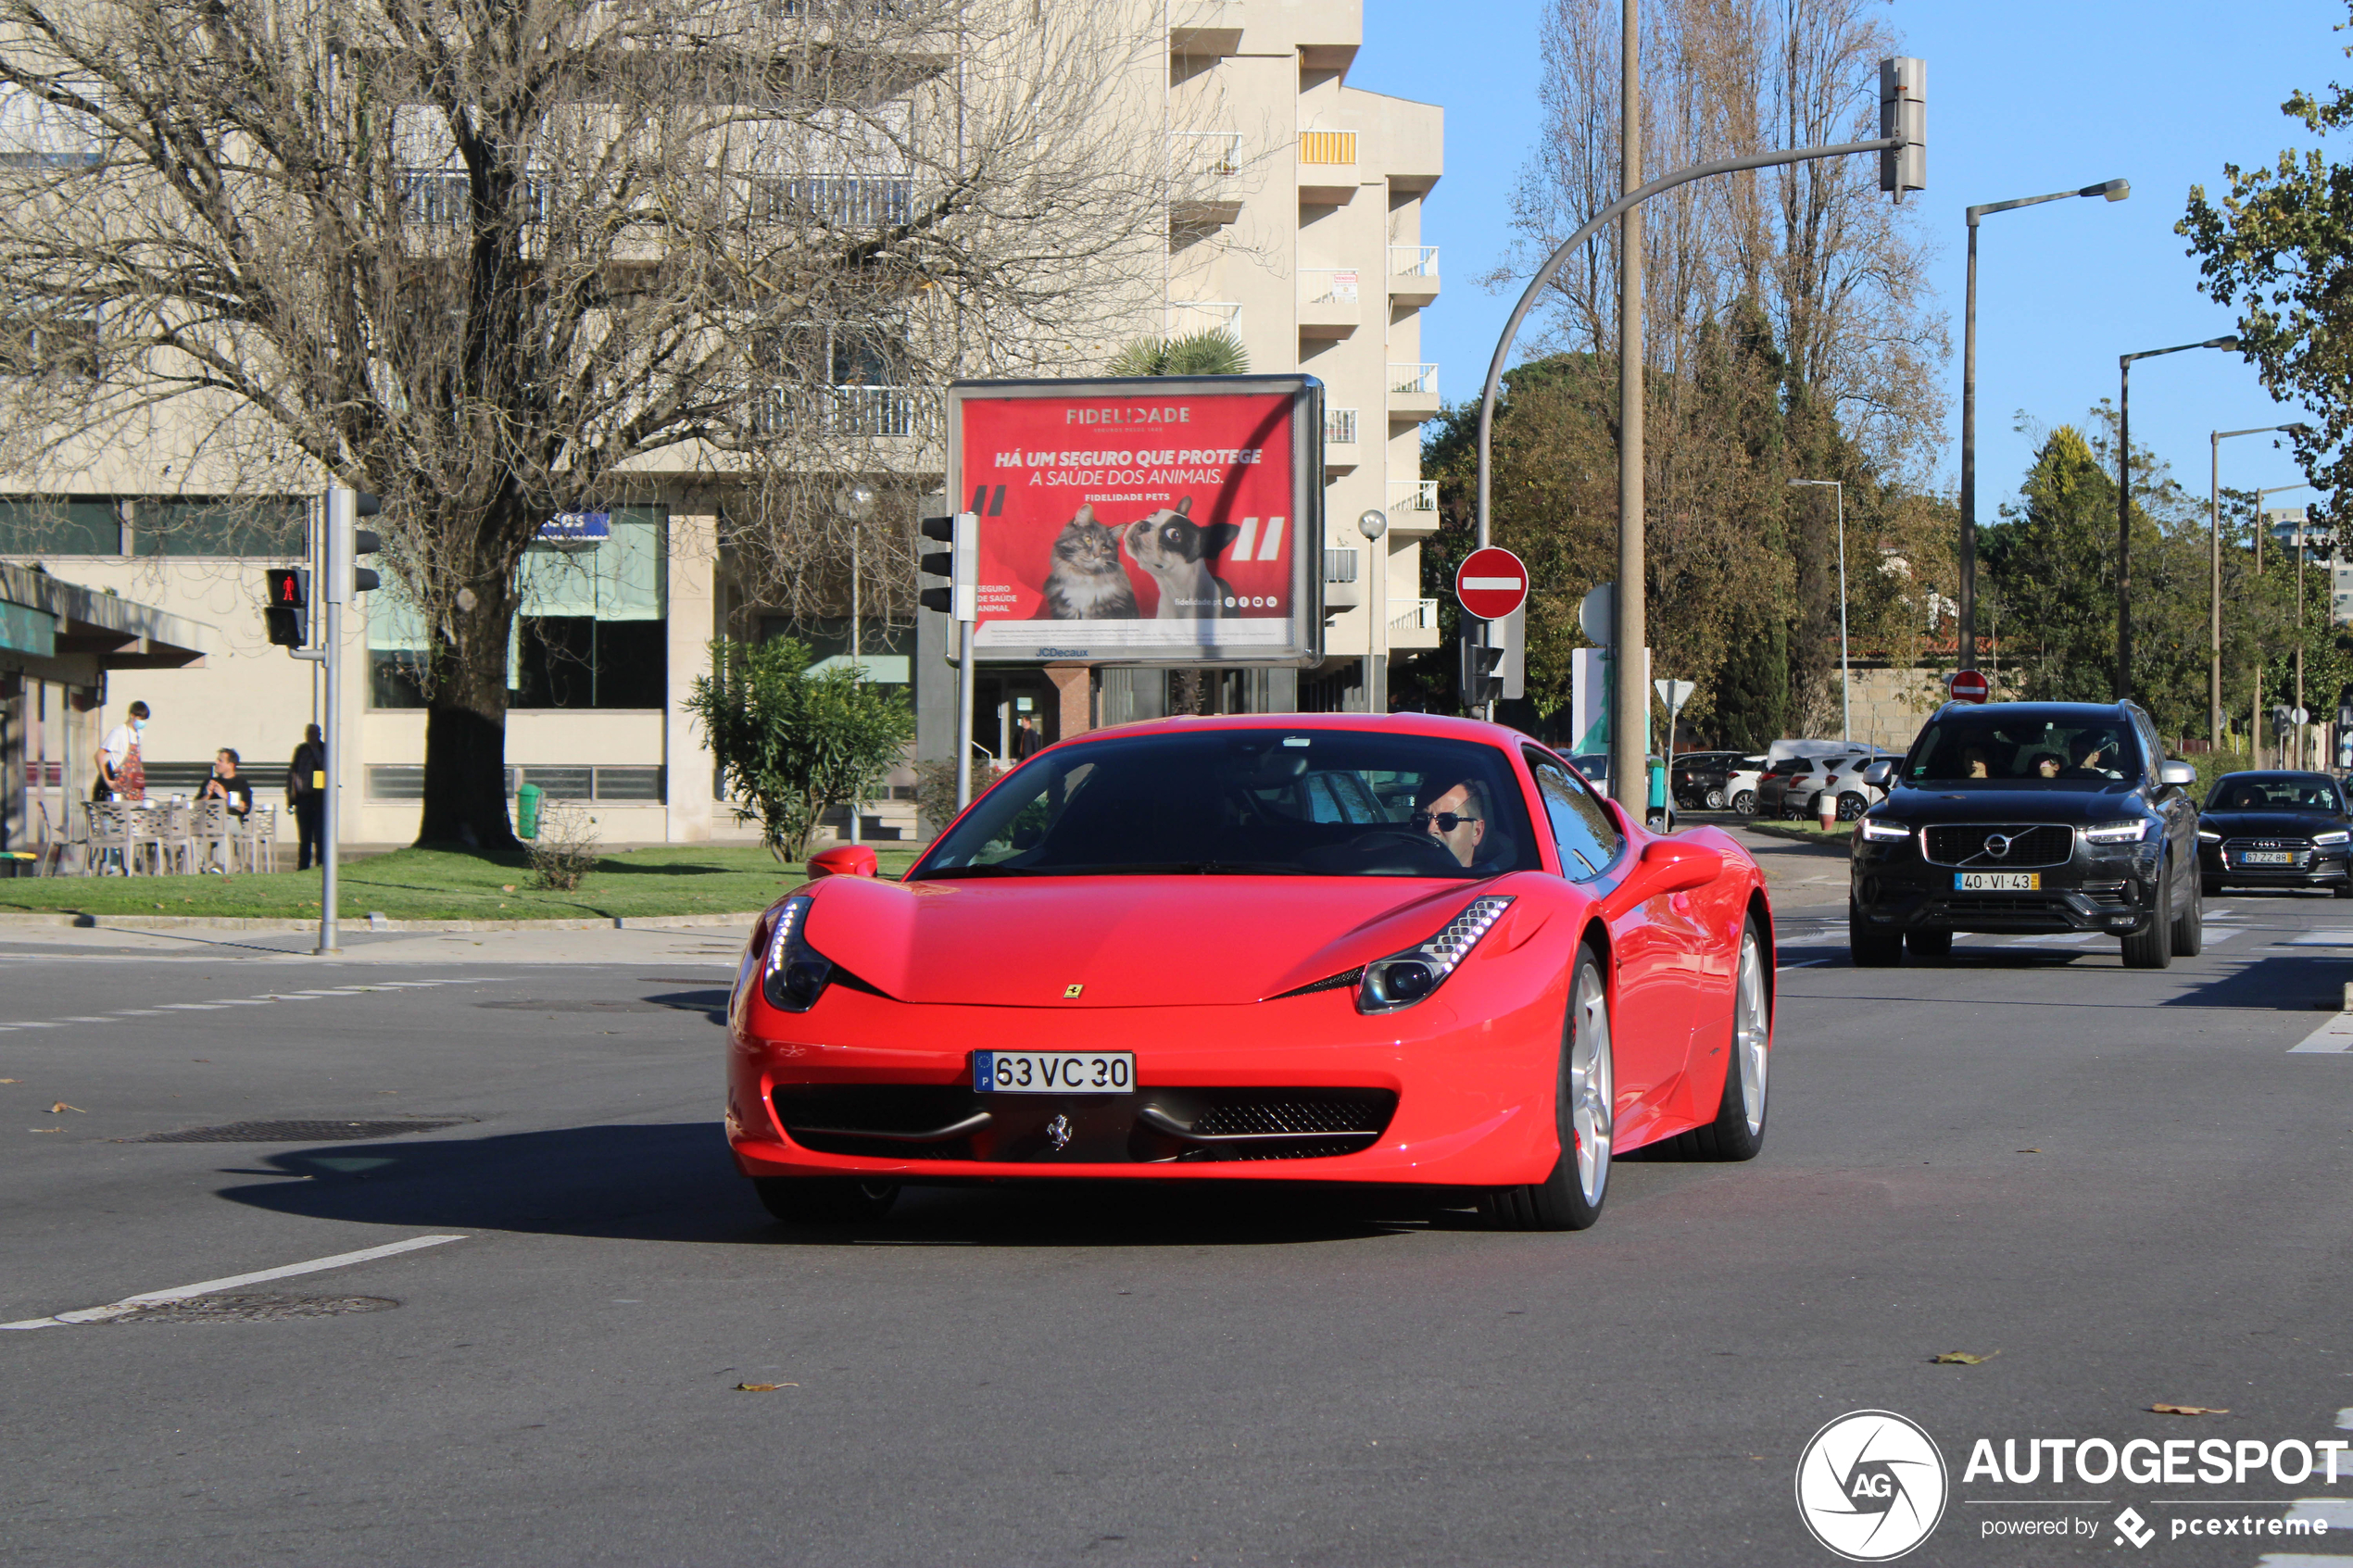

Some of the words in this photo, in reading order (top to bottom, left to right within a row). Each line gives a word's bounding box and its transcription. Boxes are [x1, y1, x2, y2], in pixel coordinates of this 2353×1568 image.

[1066, 408, 1190, 424] FIDELIDADE
[995, 448, 1023, 467] HÁ
[1026, 452, 1056, 466] UM
[1059, 450, 1133, 466] SEGURO
[1136, 449, 1176, 468] QUE
[1177, 448, 1263, 465] PROTEGE
[1029, 470, 1043, 486] A
[1046, 467, 1104, 486] SAÚDE
[1107, 470, 1145, 485] DOS
[1147, 468, 1225, 484] ANIMAIS.
[1085, 494, 1143, 502] FIDELIDADE
[1145, 493, 1170, 501] PETS
[977, 584, 1011, 593] SEGURO
[989, 594, 1017, 602] SAÚDE
[1175, 598, 1222, 608] fidelidade.pt
[1036, 647, 1088, 658] JCDecaux
[982, 1076, 989, 1086] P
